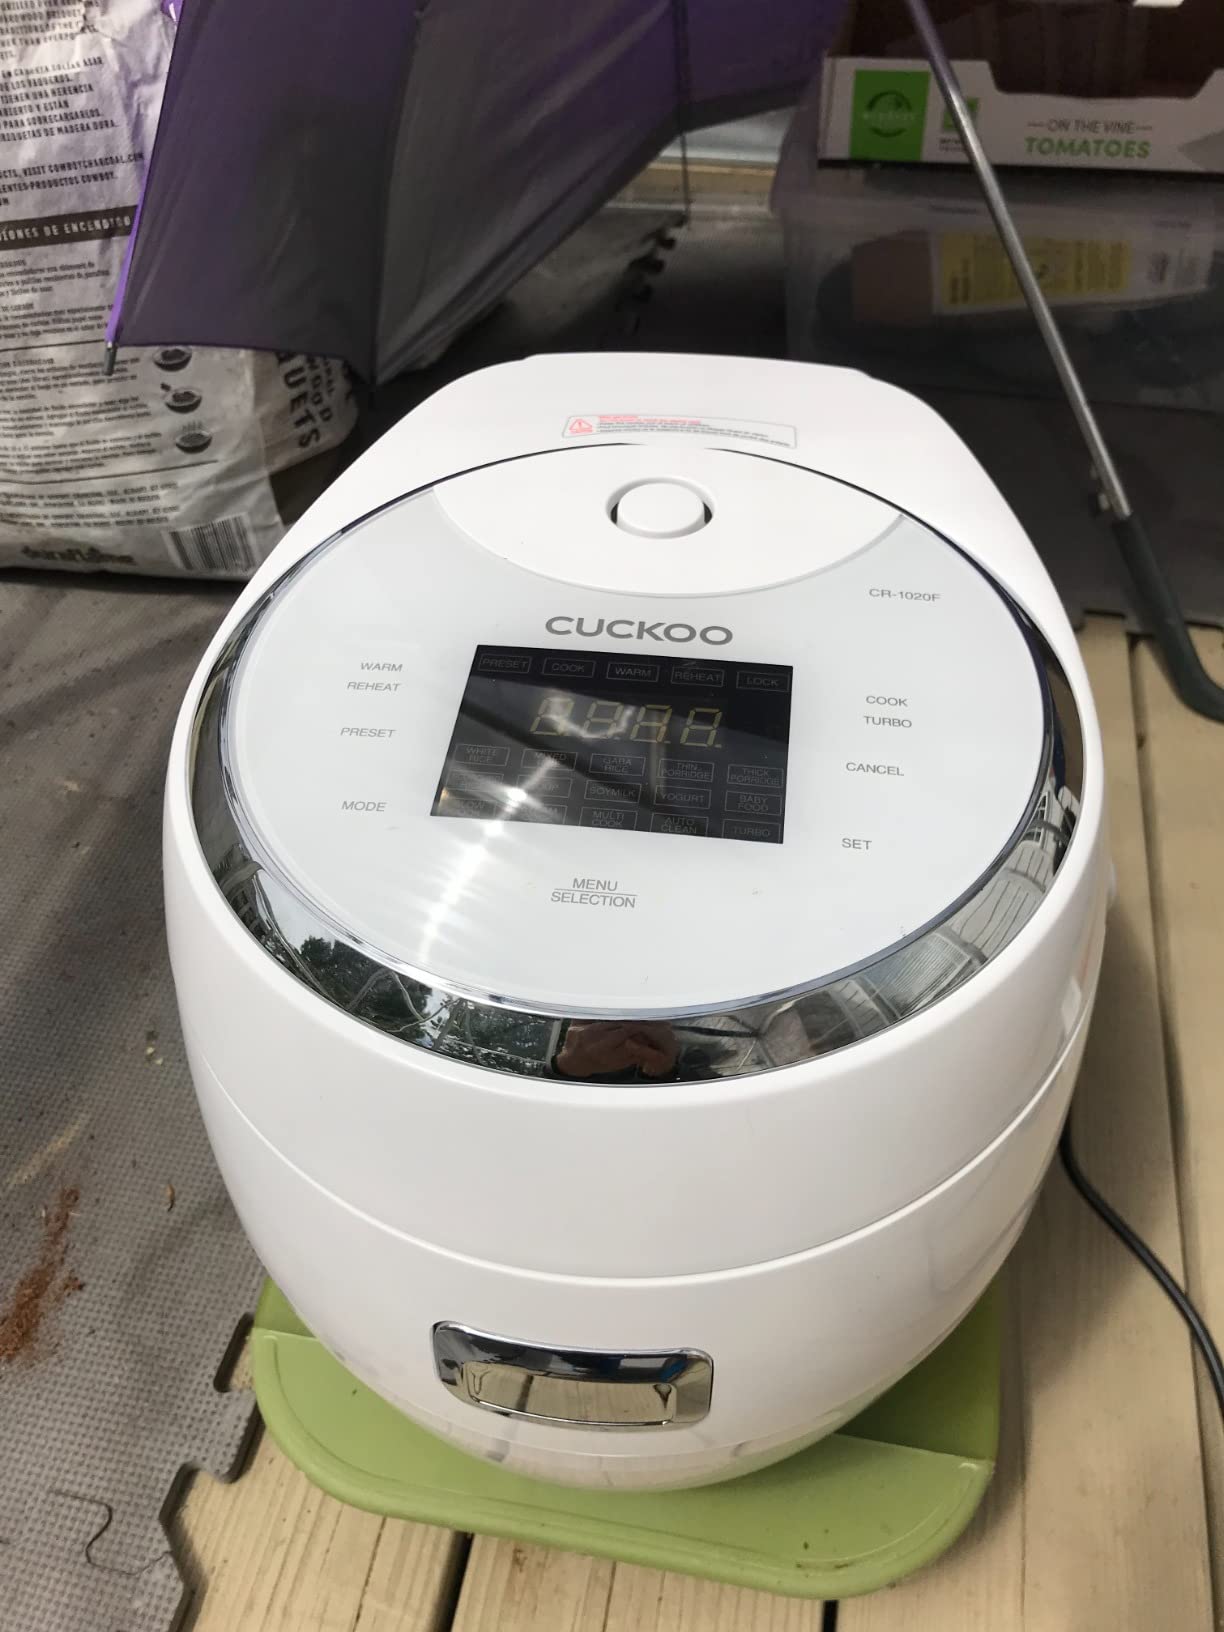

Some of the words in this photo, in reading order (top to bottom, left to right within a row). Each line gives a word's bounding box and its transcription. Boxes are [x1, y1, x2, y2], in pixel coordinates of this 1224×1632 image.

[1047, 118, 1070, 132] ON
[1074, 119, 1100, 133] THE
[1102, 120, 1136, 134] VINE
[1024, 136, 1152, 158] TOMATOES
[43, 223, 60, 237] DE
[868, 587, 942, 603] CR-1020F
[545, 615, 734, 646] CUCKOO
[360, 661, 403, 673] WARM
[480, 656, 529, 671] PRESET
[551, 661, 586, 674] COOK
[613, 664, 653, 679] WARM
[674, 669, 723, 683] REHEAT
[346, 680, 402, 693] REHEAT
[746, 675, 780, 688] LOCK
[865, 694, 909, 708] COOK
[863, 715, 913, 729] TURBO
[340, 726, 398, 739] PRESET
[741, 766, 770, 779] THICK
[845, 761, 905, 778] CANCEL
[660, 790, 706, 805] YOGURT
[340, 800, 388, 813] MODE
[736, 802, 769, 814] FOOD
[664, 816, 696, 828] AUTO
[732, 826, 773, 838] TURBO
[841, 836, 873, 851] SET
[572, 877, 619, 892] MENU
[550, 891, 637, 909] SELECTION
